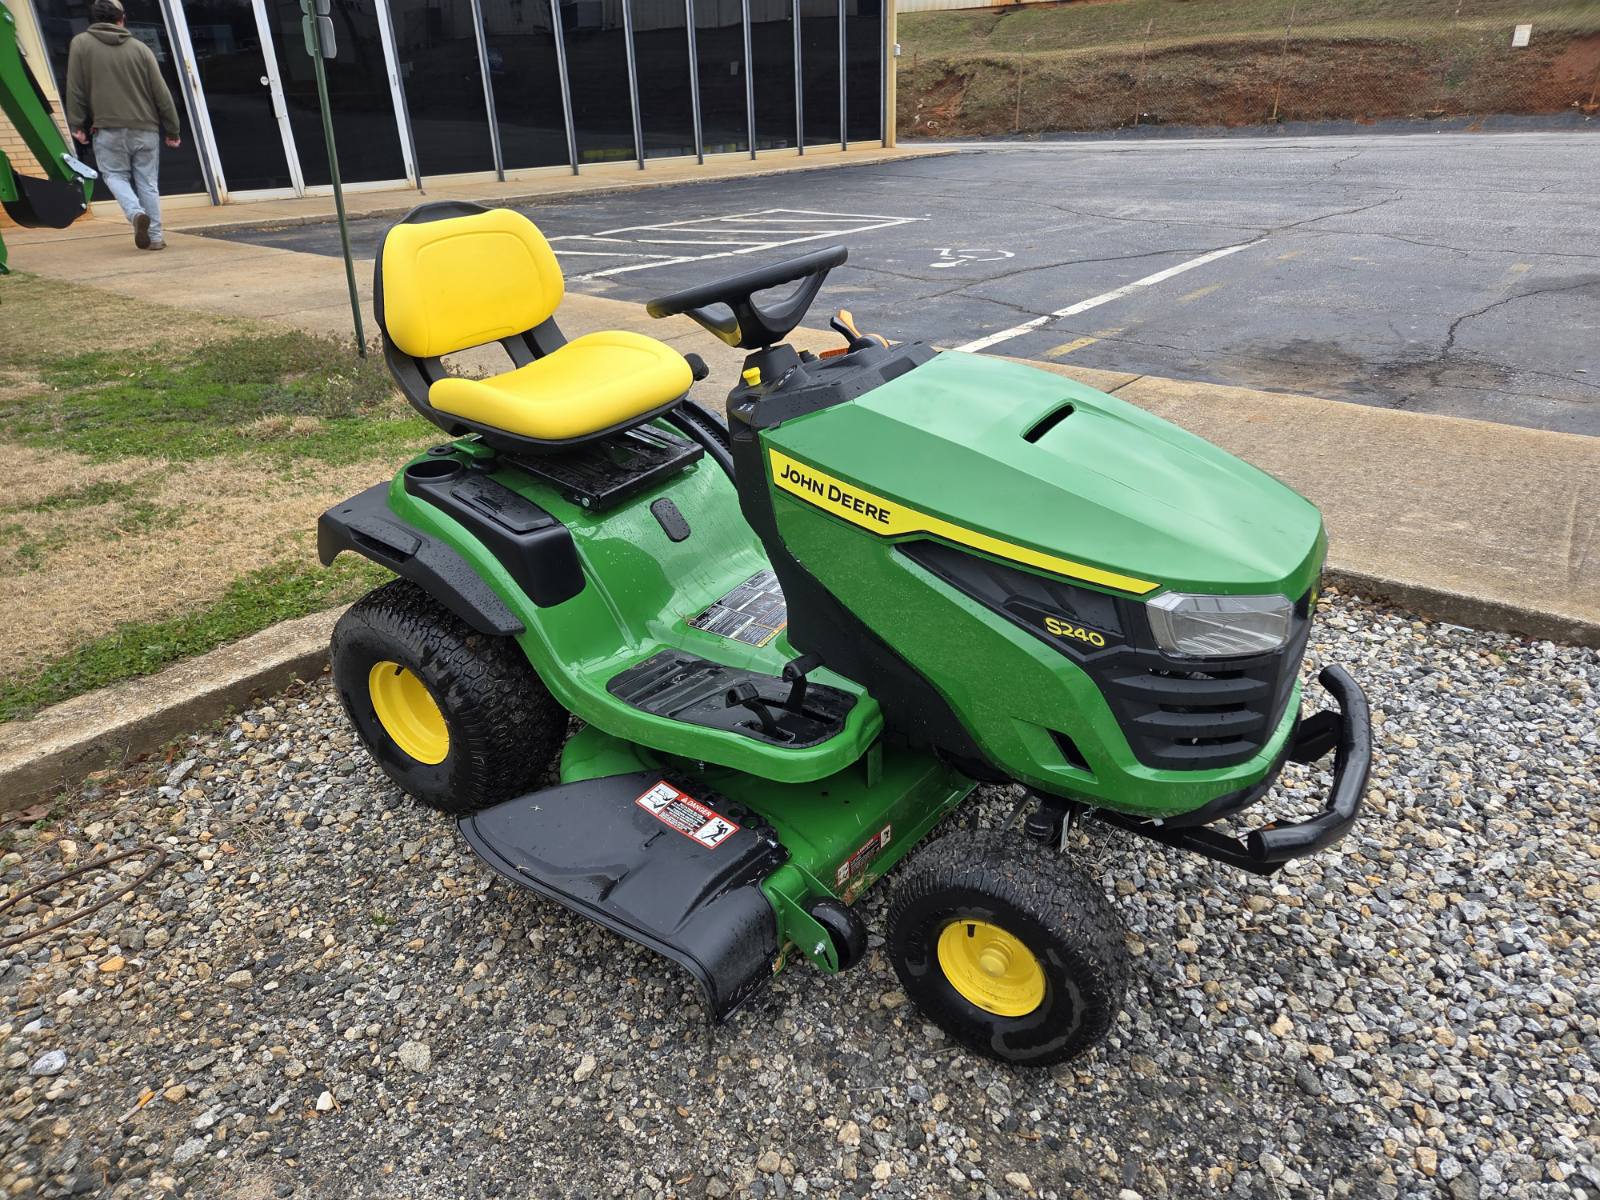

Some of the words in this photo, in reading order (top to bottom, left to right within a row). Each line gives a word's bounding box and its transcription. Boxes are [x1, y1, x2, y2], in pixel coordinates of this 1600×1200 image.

[780, 464, 824, 496] JOHN
[828, 484, 891, 524] DEERE
[1045, 617, 1105, 647] S240
[686, 800, 713, 817] DANGER
